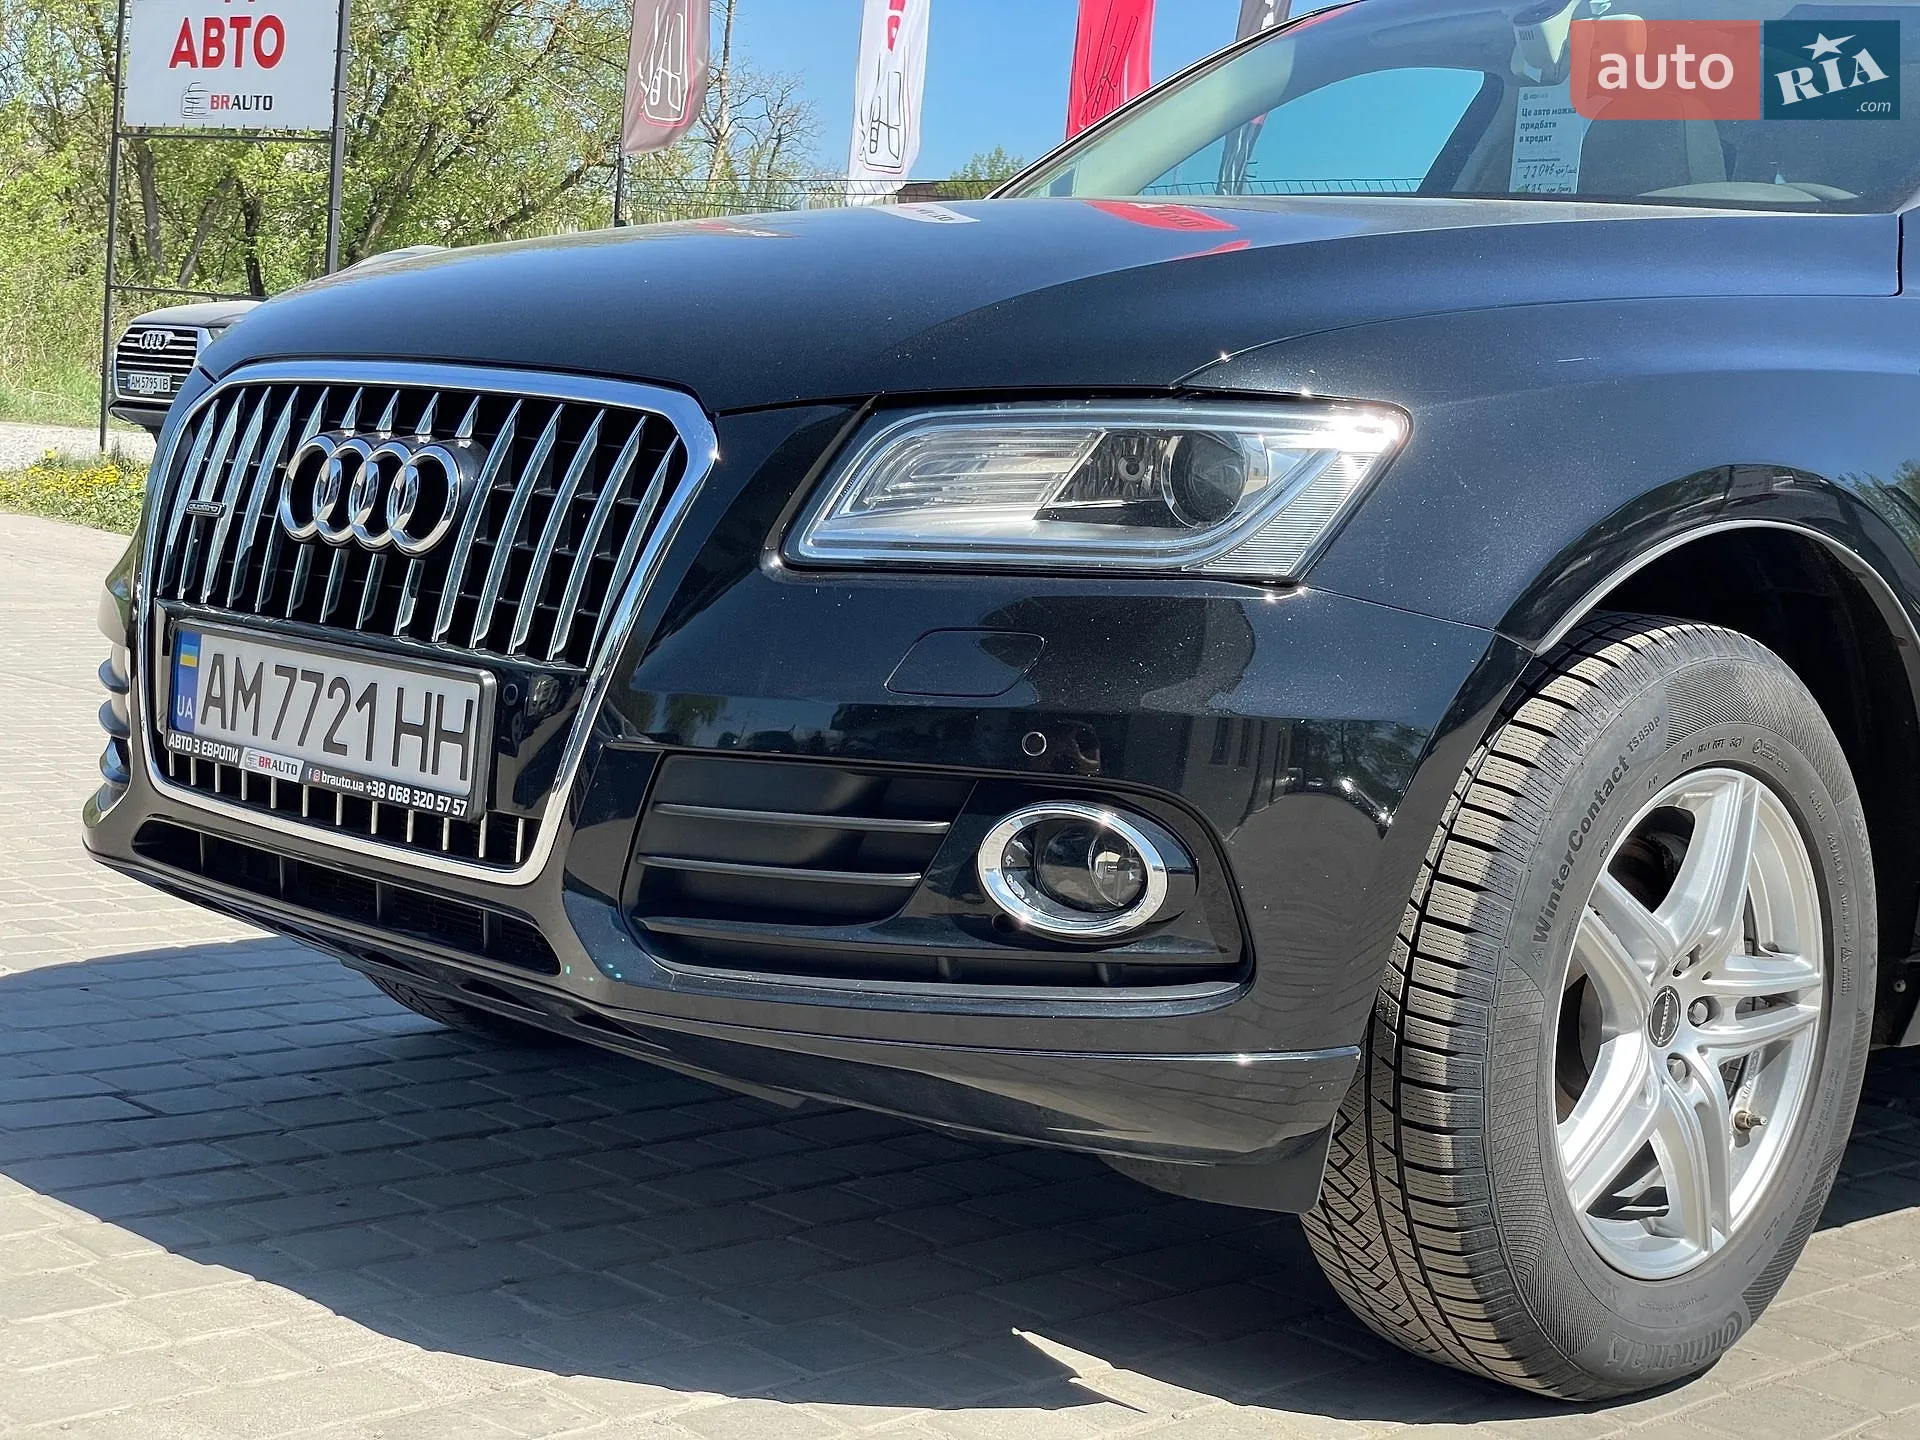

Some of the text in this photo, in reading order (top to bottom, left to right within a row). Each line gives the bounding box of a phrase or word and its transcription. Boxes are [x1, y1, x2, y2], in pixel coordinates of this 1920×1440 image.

[168, 14, 287, 70] АВТО
[209, 94, 274, 111] BRAUTO
[1520, 120, 1557, 131] придбати
[176, 695, 193, 720] UA
[200, 653, 474, 781] AM 7721 HH
[168, 732, 193, 752] АВТО
[258, 755, 298, 776] BRAUTO
[321, 770, 468, 817] brauto.ua +38 068 320 57 57
[1532, 754, 1631, 944] WinterContact
